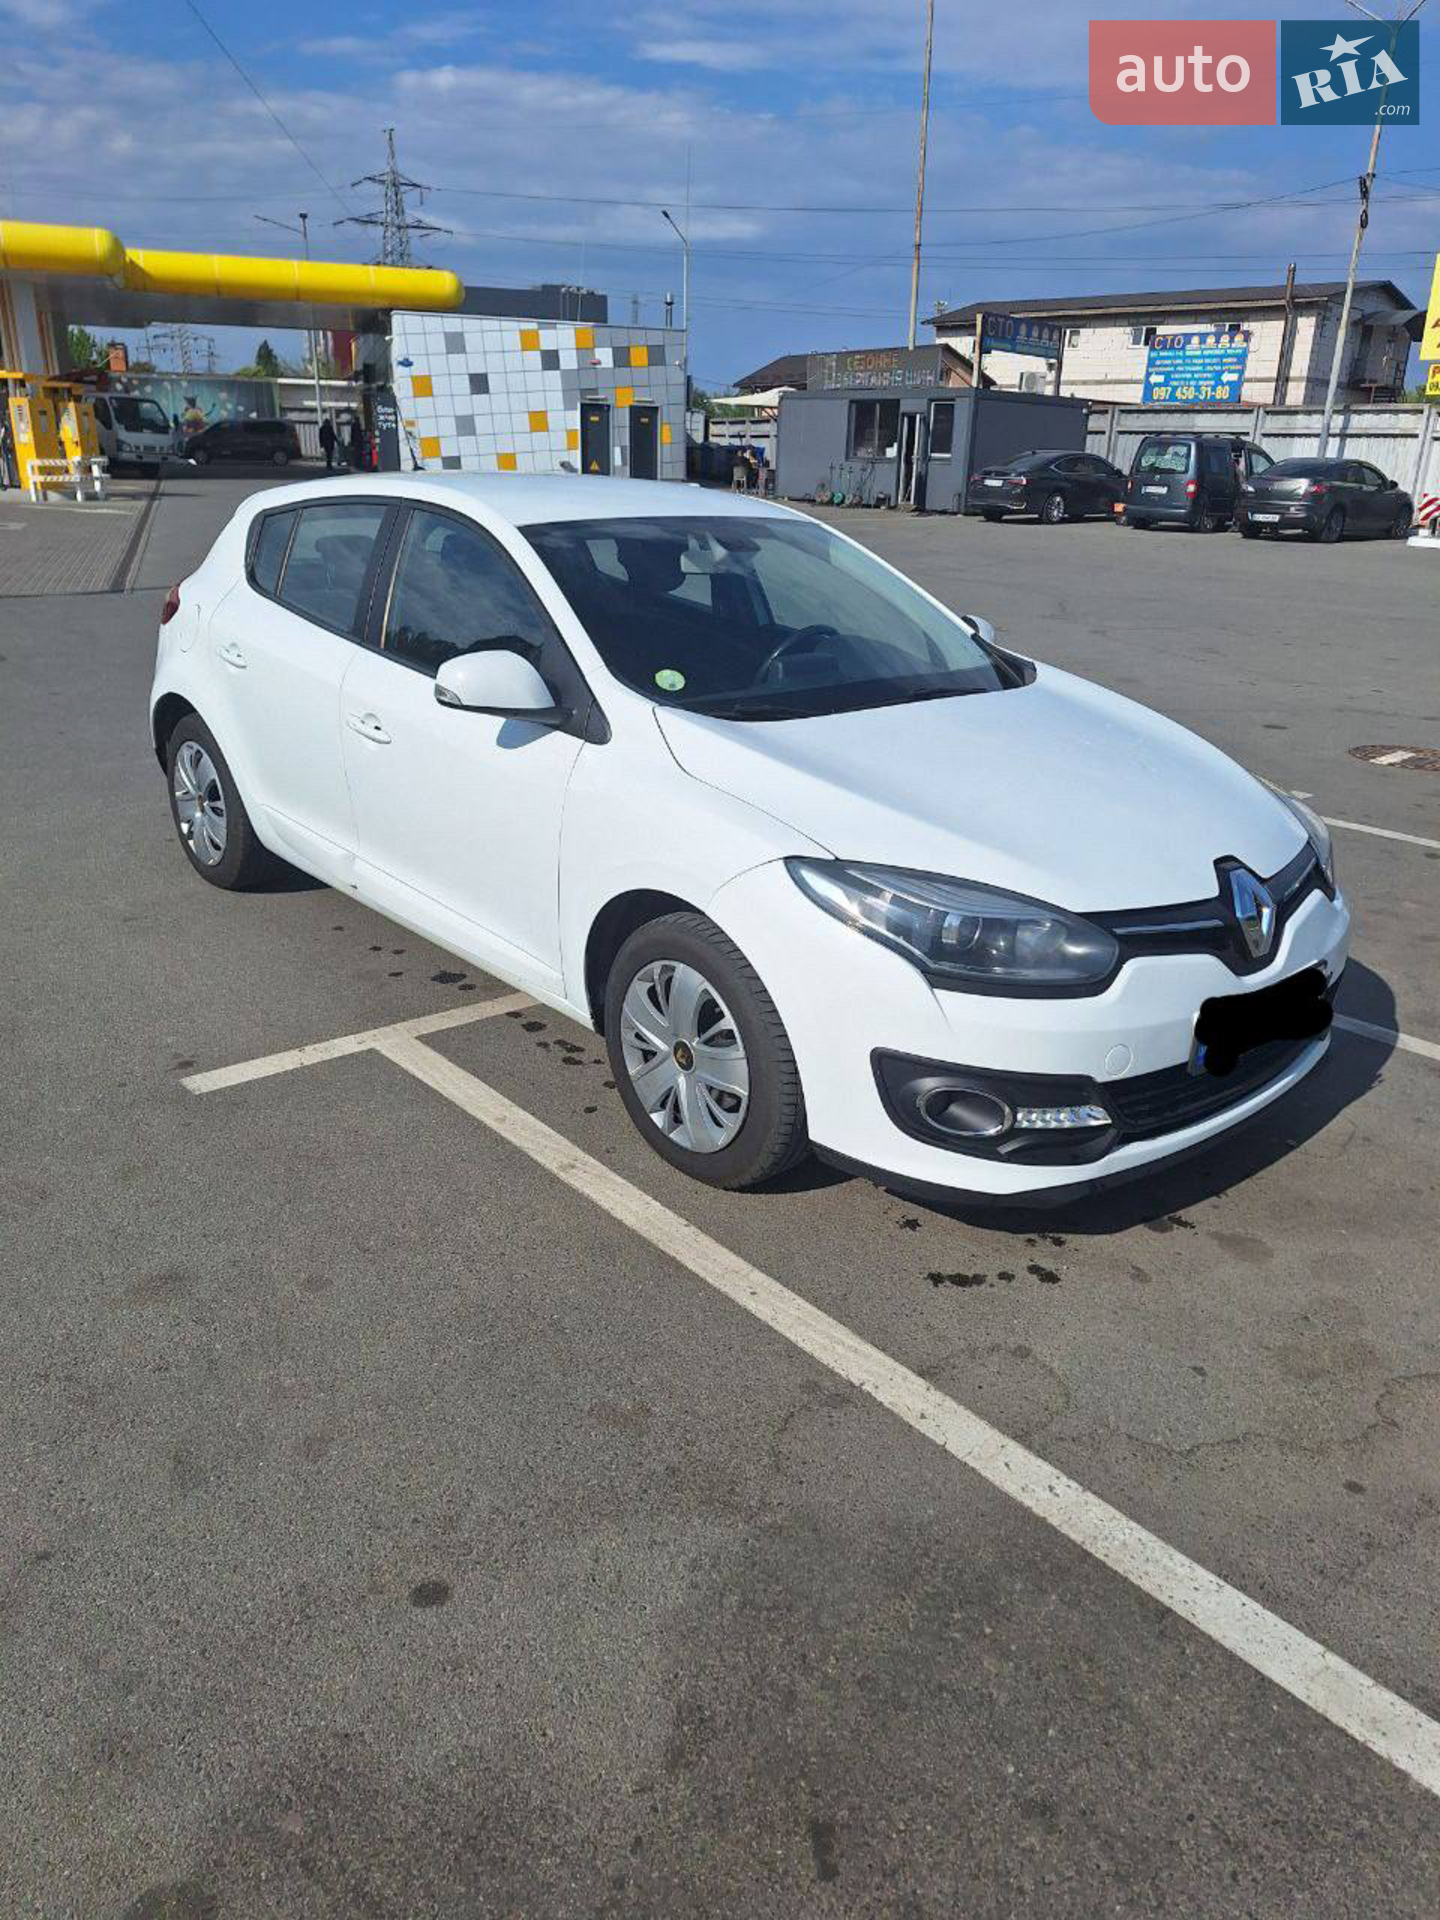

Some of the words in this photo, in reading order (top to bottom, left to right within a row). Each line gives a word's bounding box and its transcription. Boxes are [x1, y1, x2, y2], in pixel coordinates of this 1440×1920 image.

[987, 316, 1014, 336] СТО
[1155, 335, 1184, 349] СТО
[1152, 386, 1172, 400] 097
[1176, 385, 1230, 400] 450-31-80
